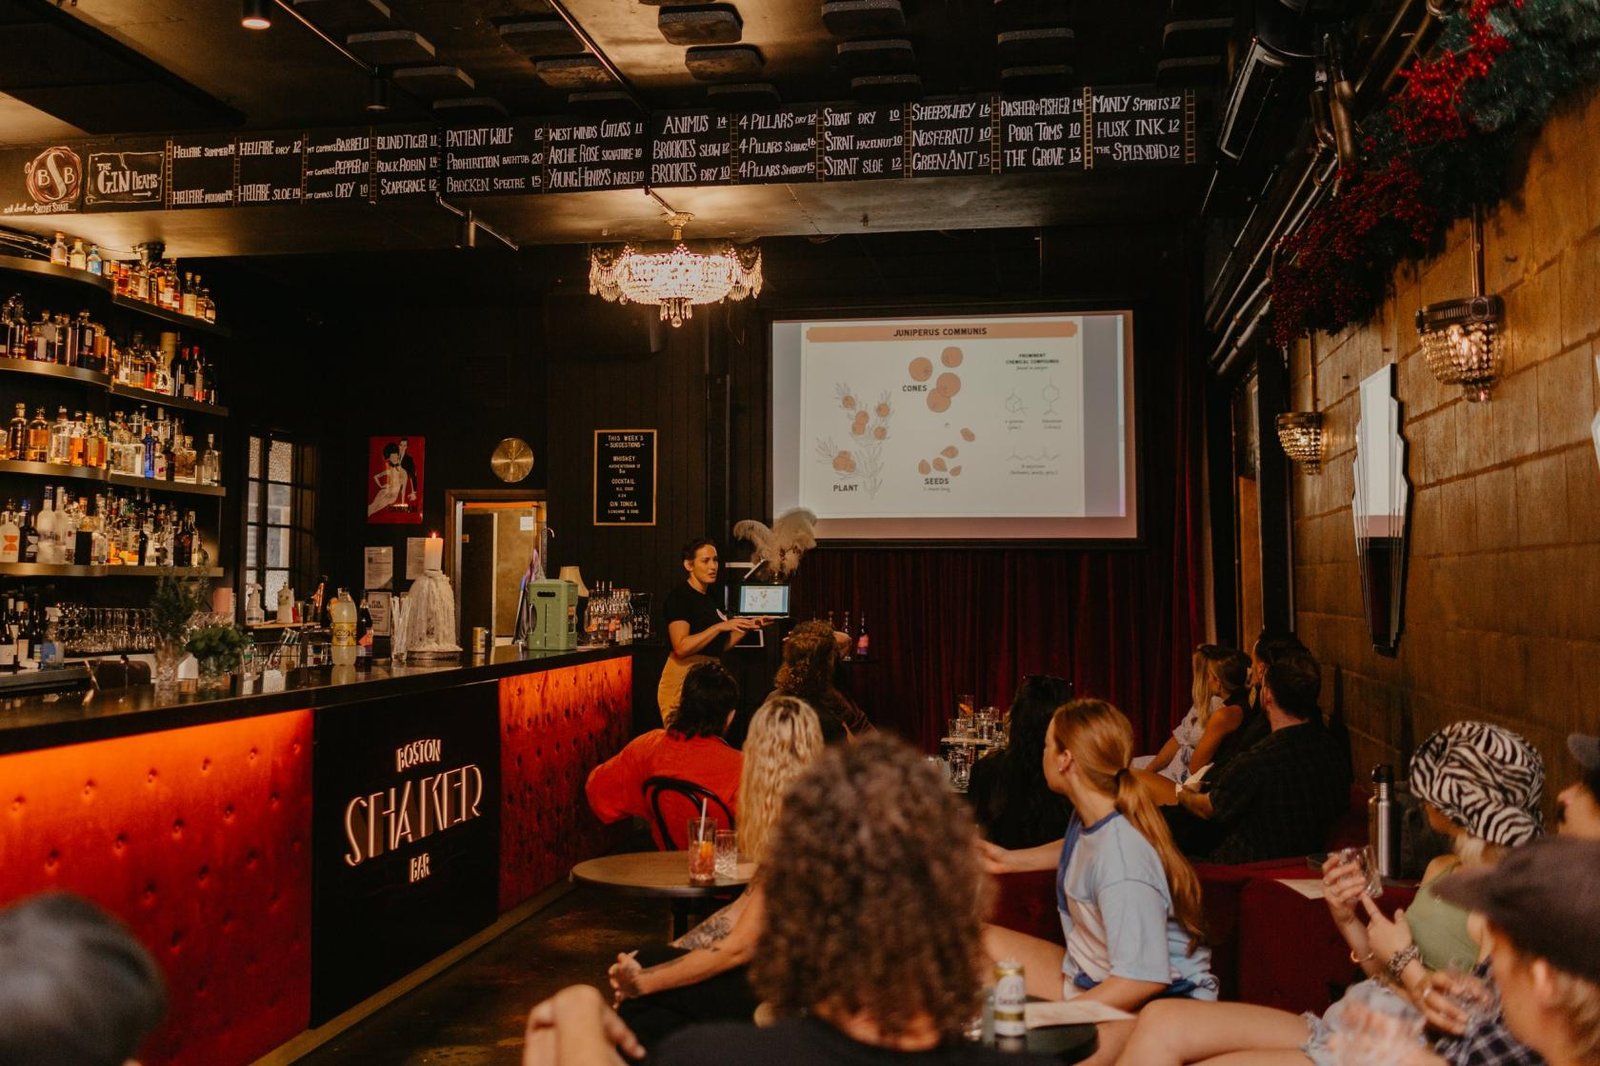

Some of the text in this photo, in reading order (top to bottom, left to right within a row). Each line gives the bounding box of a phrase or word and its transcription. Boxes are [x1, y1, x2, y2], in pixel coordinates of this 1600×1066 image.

[912, 102, 990, 121] SHEEPSWHEY 16
[1072, 98, 1084, 113] 14
[1092, 95, 1182, 113] MANLY SPIRITS 12
[662, 114, 727, 134] ANIMUS 14
[739, 112, 816, 130] 4 PILLARS DRY 12
[824, 108, 900, 126] STRAIT DRY 10
[446, 126, 544, 147] PATIENT WOLF 12
[549, 120, 643, 141] WEST WINDS CUTLASS 11
[912, 126, 992, 147] NOSFERATU 10
[1008, 122, 1081, 143] POOR TOMS 10
[1097, 118, 1180, 138] HUSK INK 12
[240, 140, 302, 156] HELLFIRE DRY 12
[336, 137, 362, 152] BARREL
[376, 134, 437, 150] BLIND TIGER 11
[652, 140, 730, 160] BROOKIES SLOW 12
[739, 141, 748, 154] 4
[748, 138, 783, 154] PILLARS
[808, 138, 816, 150] 16
[824, 132, 903, 152] STRAIT HAZELNUT 10
[1094, 142, 1180, 160] THE SPLENDID 12
[174, 146, 202, 158] HELLFIRE
[446, 152, 544, 170] PROHIBITION BATHTUB 20
[548, 144, 642, 164] ARCHIE ROSE SIGNATURE 10
[978, 154, 990, 167] 15
[1004, 147, 1082, 167] THE GROVE 13
[335, 158, 362, 175] PEPPER
[362, 162, 369, 173] 10
[400, 158, 426, 172] ROBIN
[652, 162, 730, 184] BROOKIES DRY 10
[739, 160, 816, 178] 4 PILLARS SHERRY 15
[824, 156, 902, 176] STRAIT SLOE 12
[98, 171, 158, 194] GIN BEAMS
[380, 178, 438, 196] SCAPEGRACE 12
[446, 176, 542, 193] BROCKEN SPECTRE 15
[548, 168, 644, 188] YOUNG HENRYS NOBLE 10
[173, 189, 204, 205] HELLFIRE
[238, 184, 271, 202] HELLFIRE
[272, 188, 292, 200] SLOE
[335, 182, 356, 198] DRY
[360, 184, 368, 197] 10
[894, 327, 987, 337] JUNIPERUS COMMUNIS
[902, 384, 928, 392] CONES
[834, 484, 858, 492] PLANT
[924, 478, 950, 486] SEEDS
[396, 739, 442, 772] BOSTON
[344, 764, 483, 866] SHAKER
[409, 852, 431, 882] BAR
